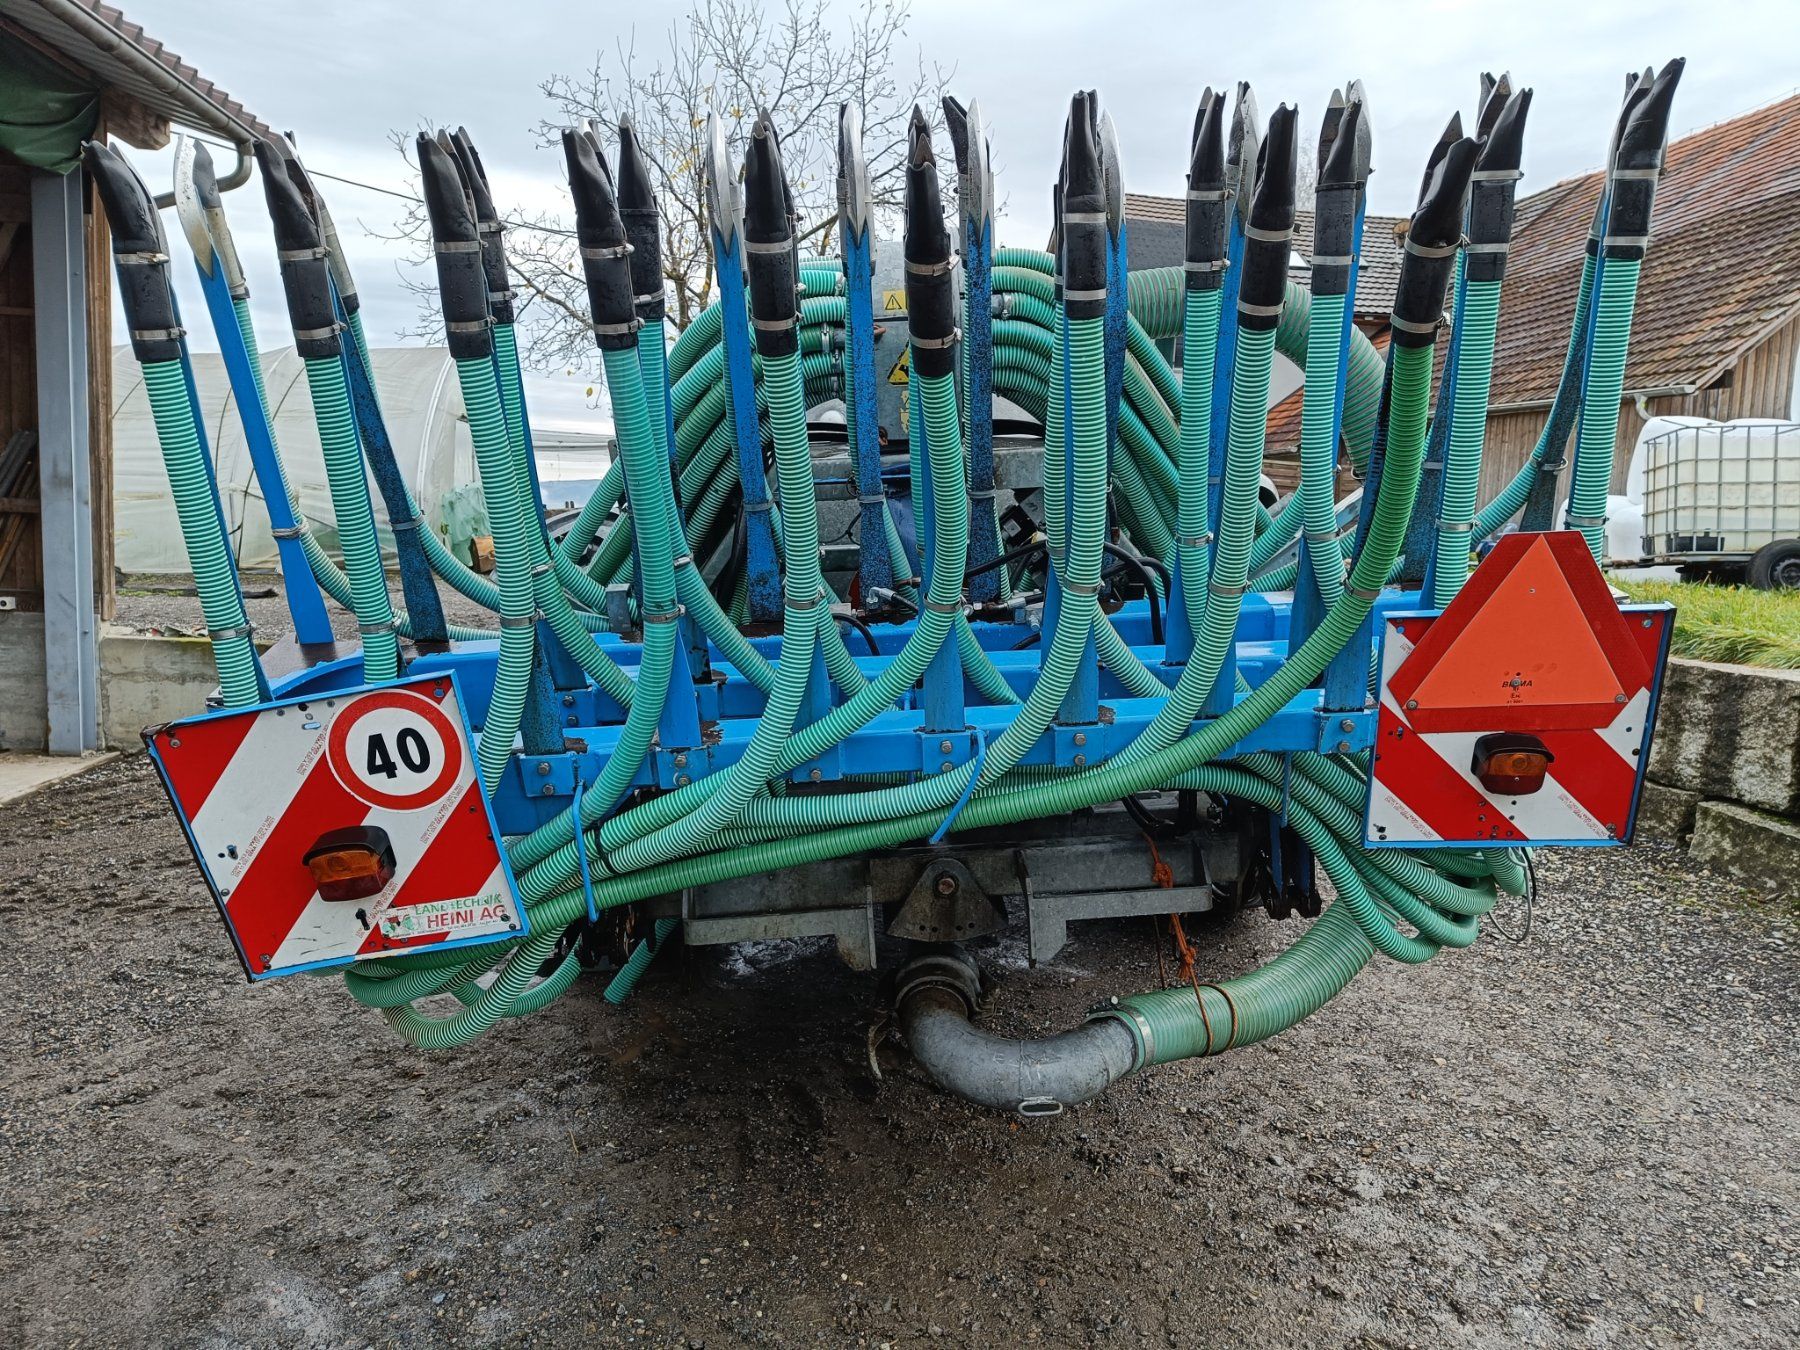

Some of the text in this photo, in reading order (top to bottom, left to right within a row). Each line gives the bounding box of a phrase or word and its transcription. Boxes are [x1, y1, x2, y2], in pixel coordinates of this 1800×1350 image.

[367, 728, 430, 779] 40
[427, 909, 474, 929] HEINI
[480, 904, 507, 921] AG
